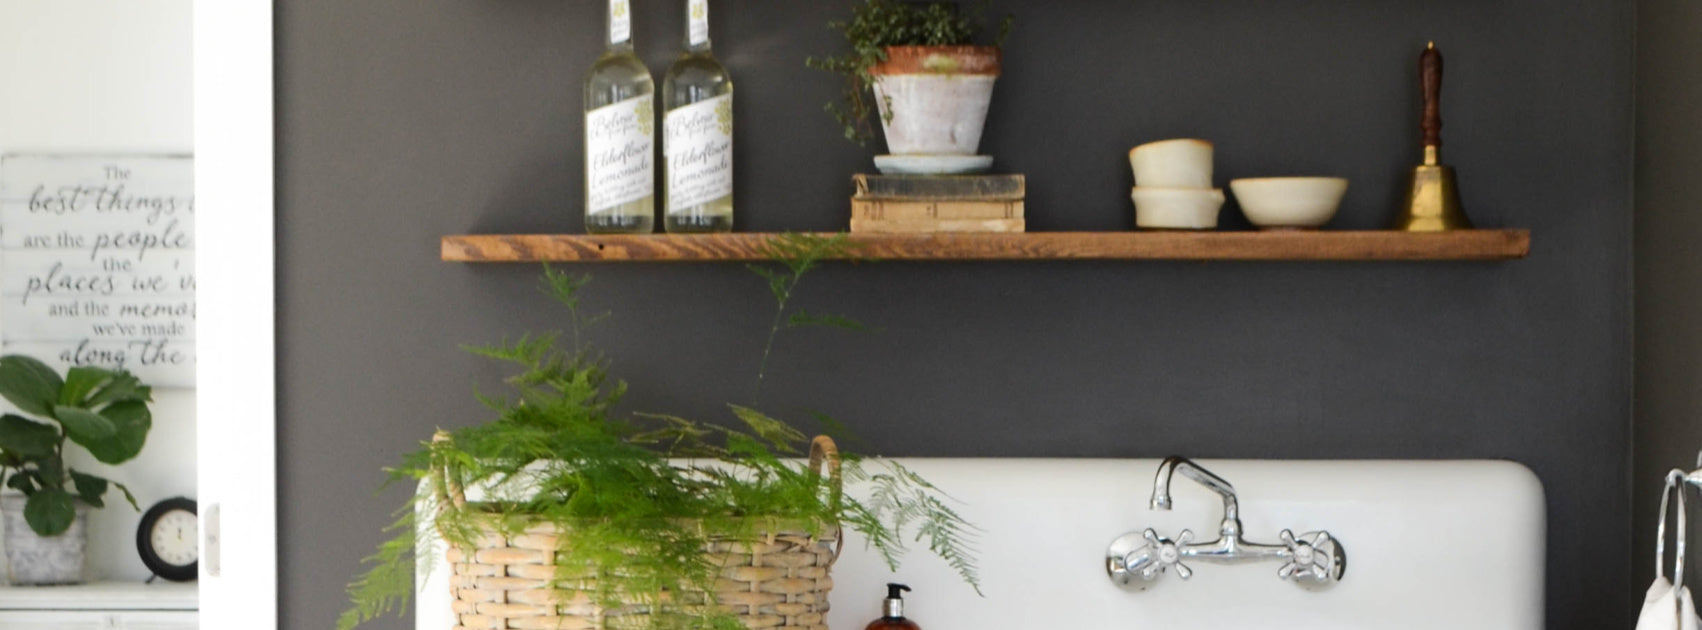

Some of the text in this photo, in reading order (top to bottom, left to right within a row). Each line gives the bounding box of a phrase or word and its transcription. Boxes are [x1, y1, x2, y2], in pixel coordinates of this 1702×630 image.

[103, 165, 131, 180] The
[28, 185, 83, 215] best
[85, 185, 175, 225] things
[23, 218, 187, 261] are the people
[102, 256, 132, 272] the
[22, 262, 114, 306] places
[49, 301, 196, 320] and the memo
[93, 320, 184, 337] we've made
[60, 338, 126, 372] along
[128, 338, 186, 366] the
